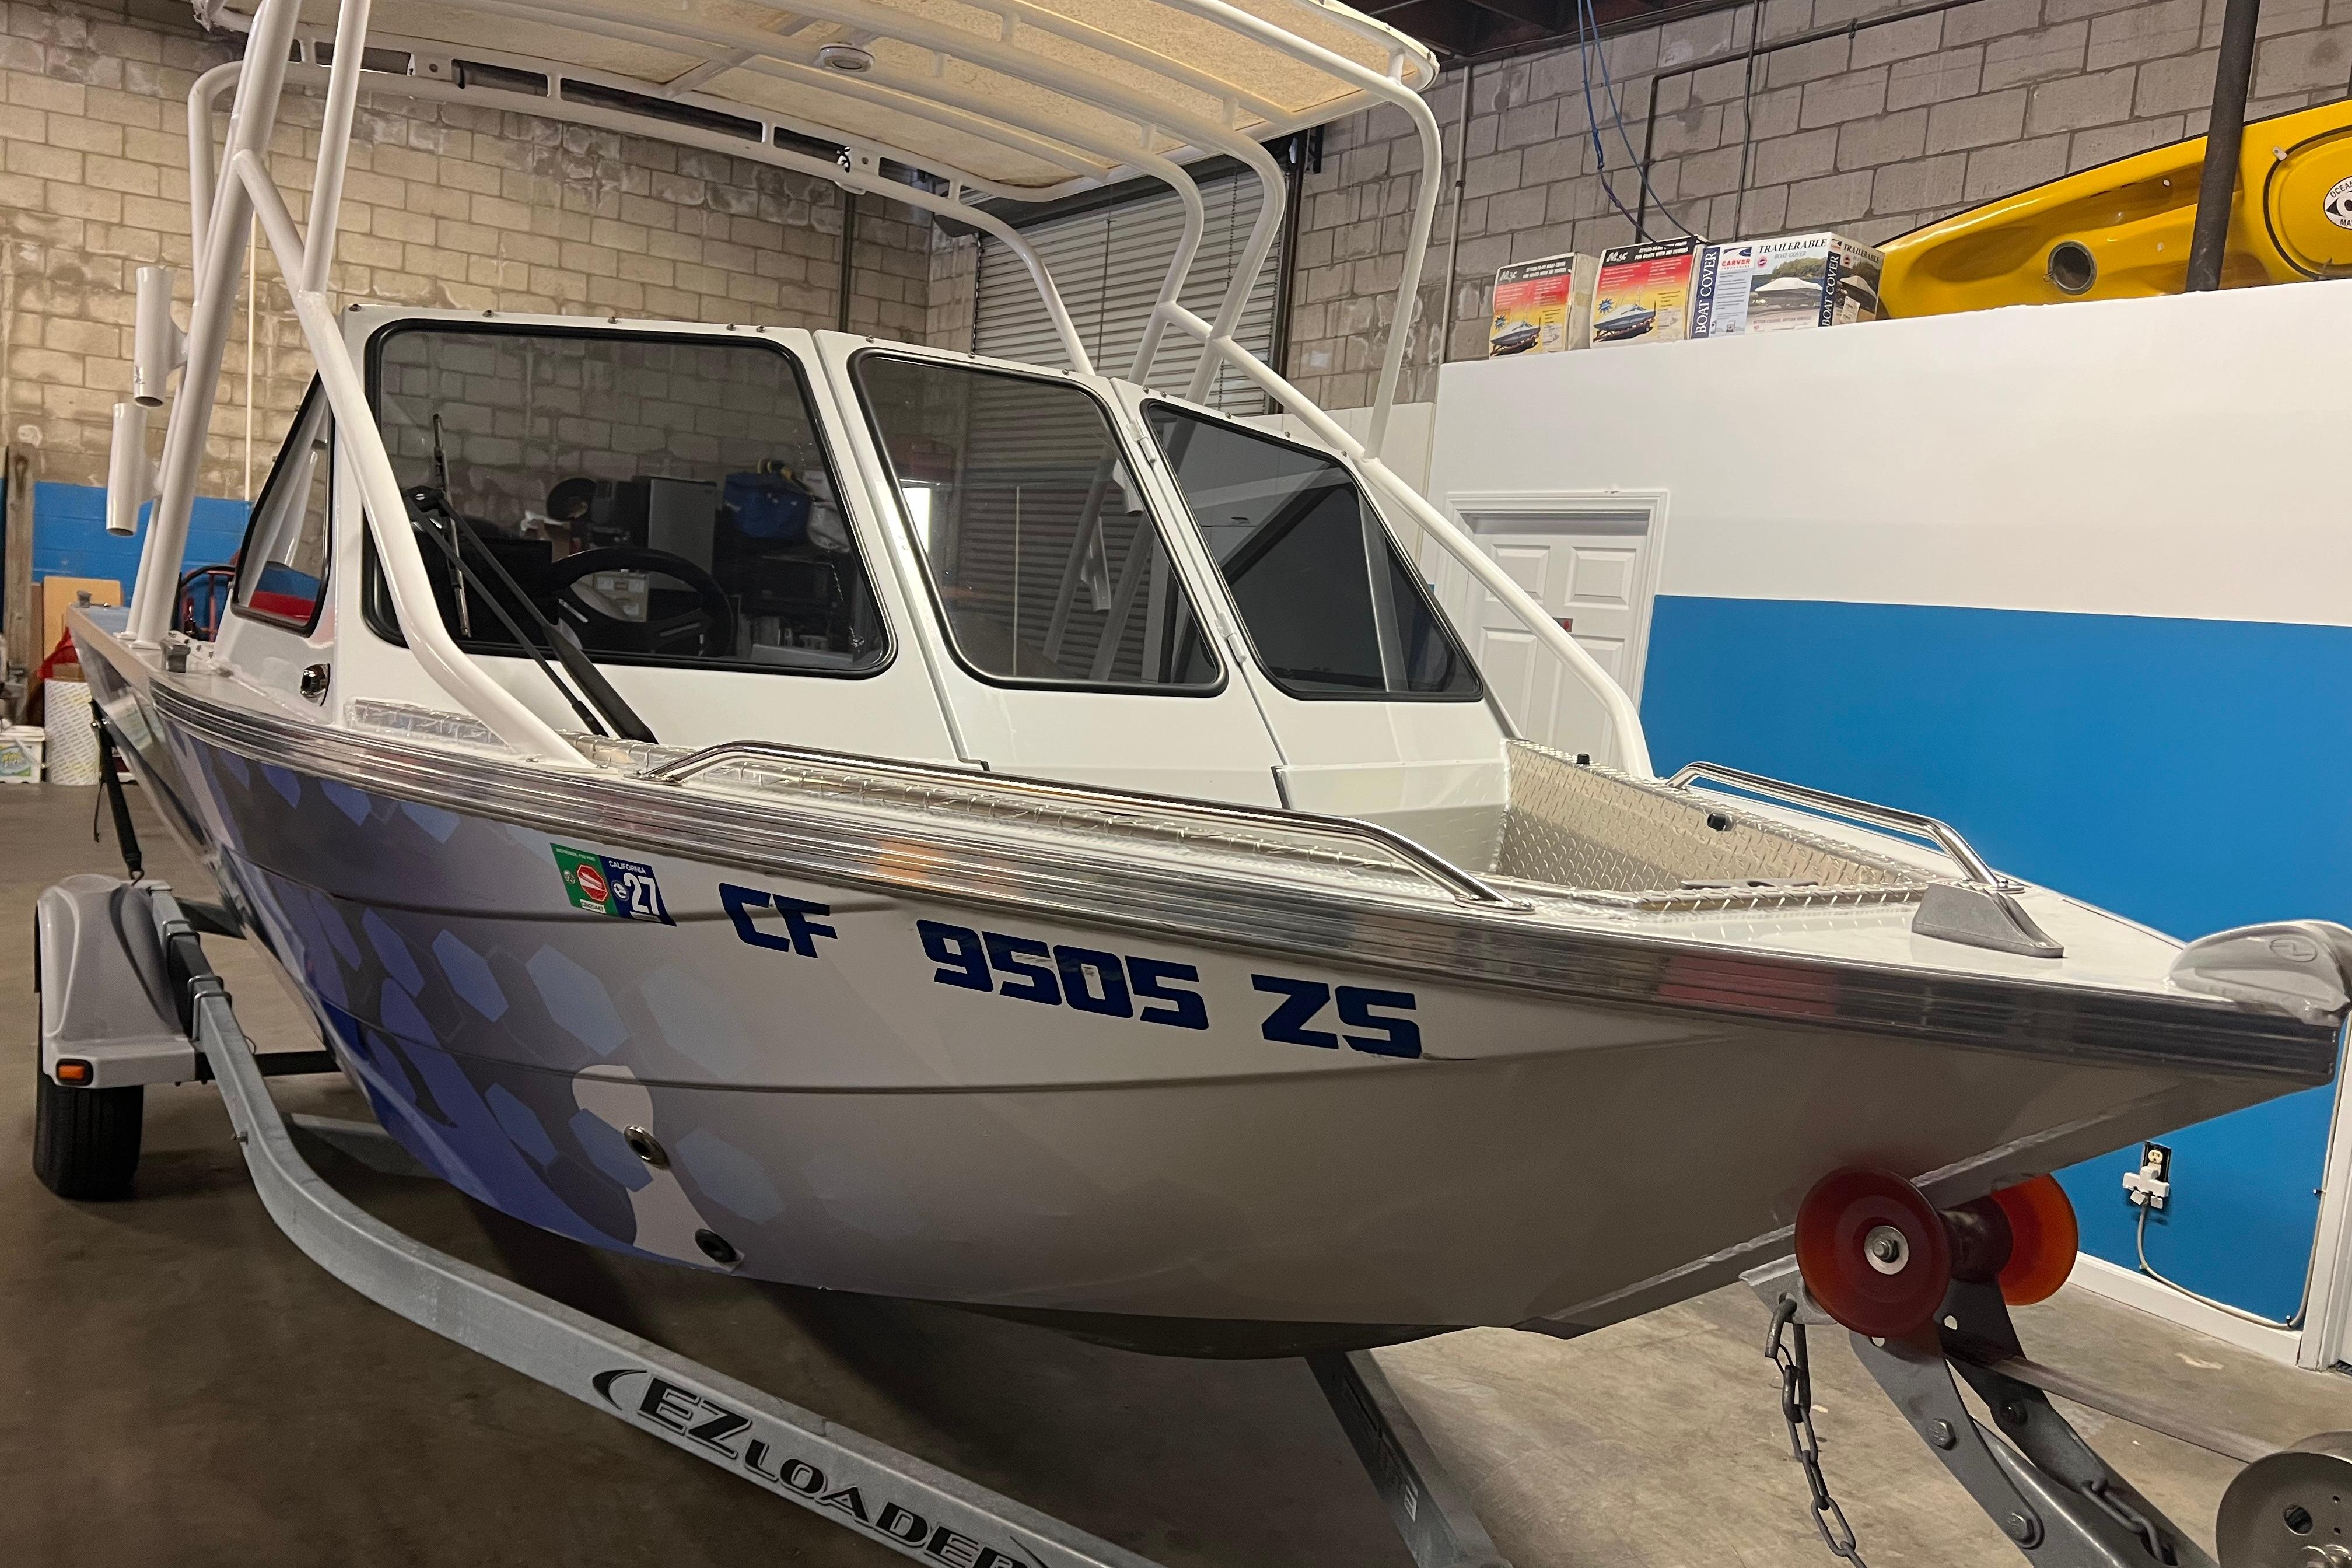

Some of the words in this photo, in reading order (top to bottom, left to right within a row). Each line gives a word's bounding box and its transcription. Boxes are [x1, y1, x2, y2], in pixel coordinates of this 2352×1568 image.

[2340, 218, 2352, 226] MA
[1758, 238, 1828, 254] TRAILERABLE
[1843, 243, 1880, 263] TRAILERABLE
[1700, 251, 1717, 297] COVER
[1721, 258, 1751, 267] CARVER
[1826, 256, 1839, 295] COVER
[1695, 300, 1710, 334] BOAT
[1821, 296, 1833, 327] BOAT
[608, 860, 646, 874] CALIFORNIA
[623, 872, 660, 915] 27
[719, 883, 838, 958] CF
[916, 919, 1209, 1031] 9505
[1251, 974, 1423, 1059] ZS
